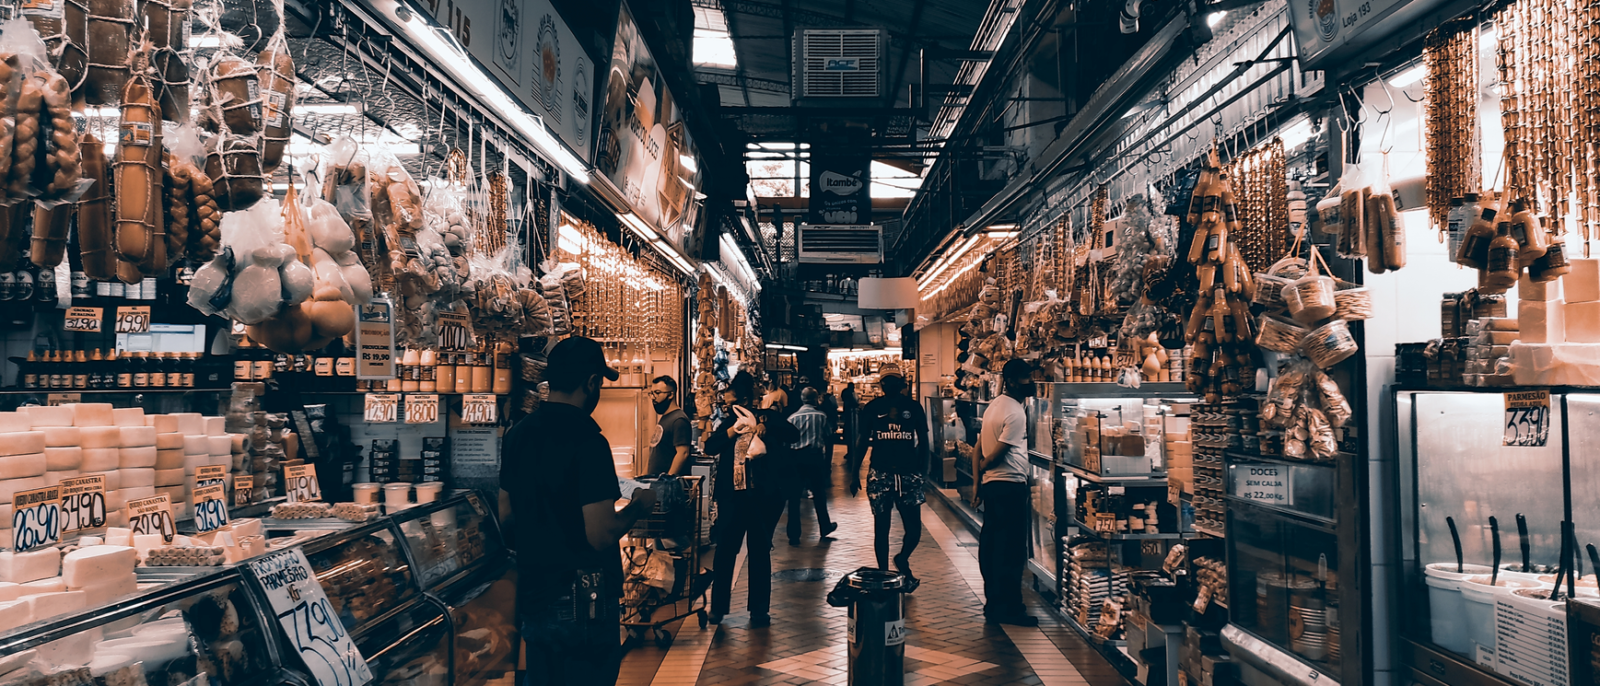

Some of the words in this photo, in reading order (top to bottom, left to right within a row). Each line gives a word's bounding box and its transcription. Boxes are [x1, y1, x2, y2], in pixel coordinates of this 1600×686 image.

[1342, 13, 1358, 28] Loja
[1358, 2, 1371, 18] 193
[826, 177, 858, 187] Itambé
[372, 353, 390, 361] 19,90
[888, 423, 902, 431] Fly
[876, 430, 912, 440] Emirates
[1251, 468, 1278, 476] DOCES
[76, 476, 102, 486] CANASTRA
[1253, 491, 1274, 499] 22,00
[129, 500, 143, 510] QUEIJO
[143, 496, 167, 507] CANASTRA
[61, 492, 106, 532] 34,90
[194, 499, 228, 532] 31,90
[13, 502, 58, 552] 26,90
[260, 565, 308, 591] PARMESÃO
